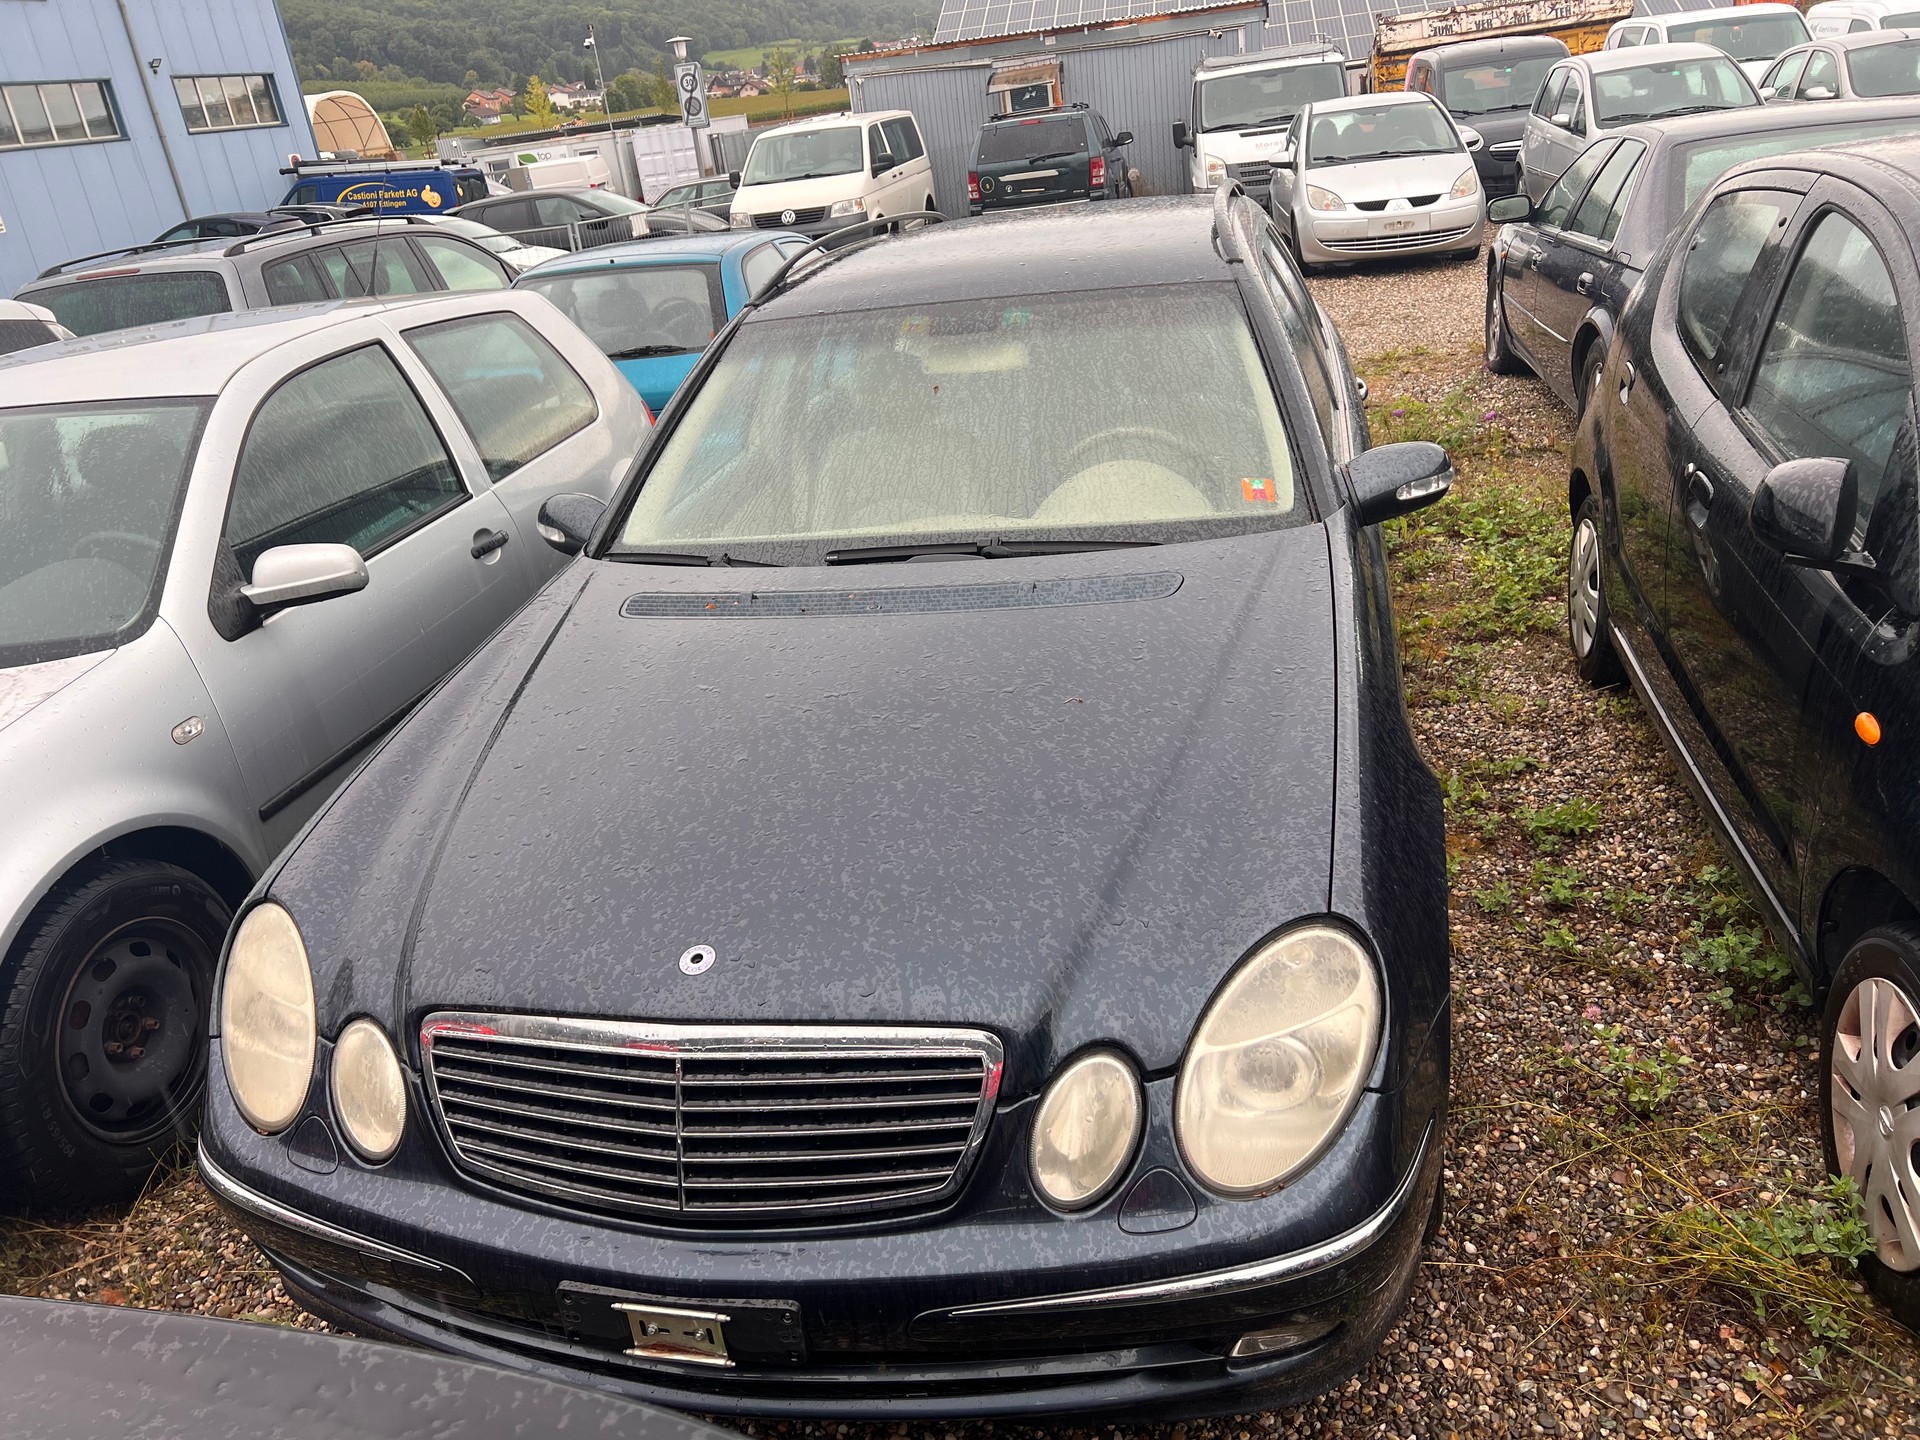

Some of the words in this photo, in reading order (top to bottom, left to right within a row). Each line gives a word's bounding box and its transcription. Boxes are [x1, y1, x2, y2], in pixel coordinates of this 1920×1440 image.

[347, 191, 378, 201] Castioni
[379, 189, 406, 200] Parkett
[406, 188, 418, 198] AG
